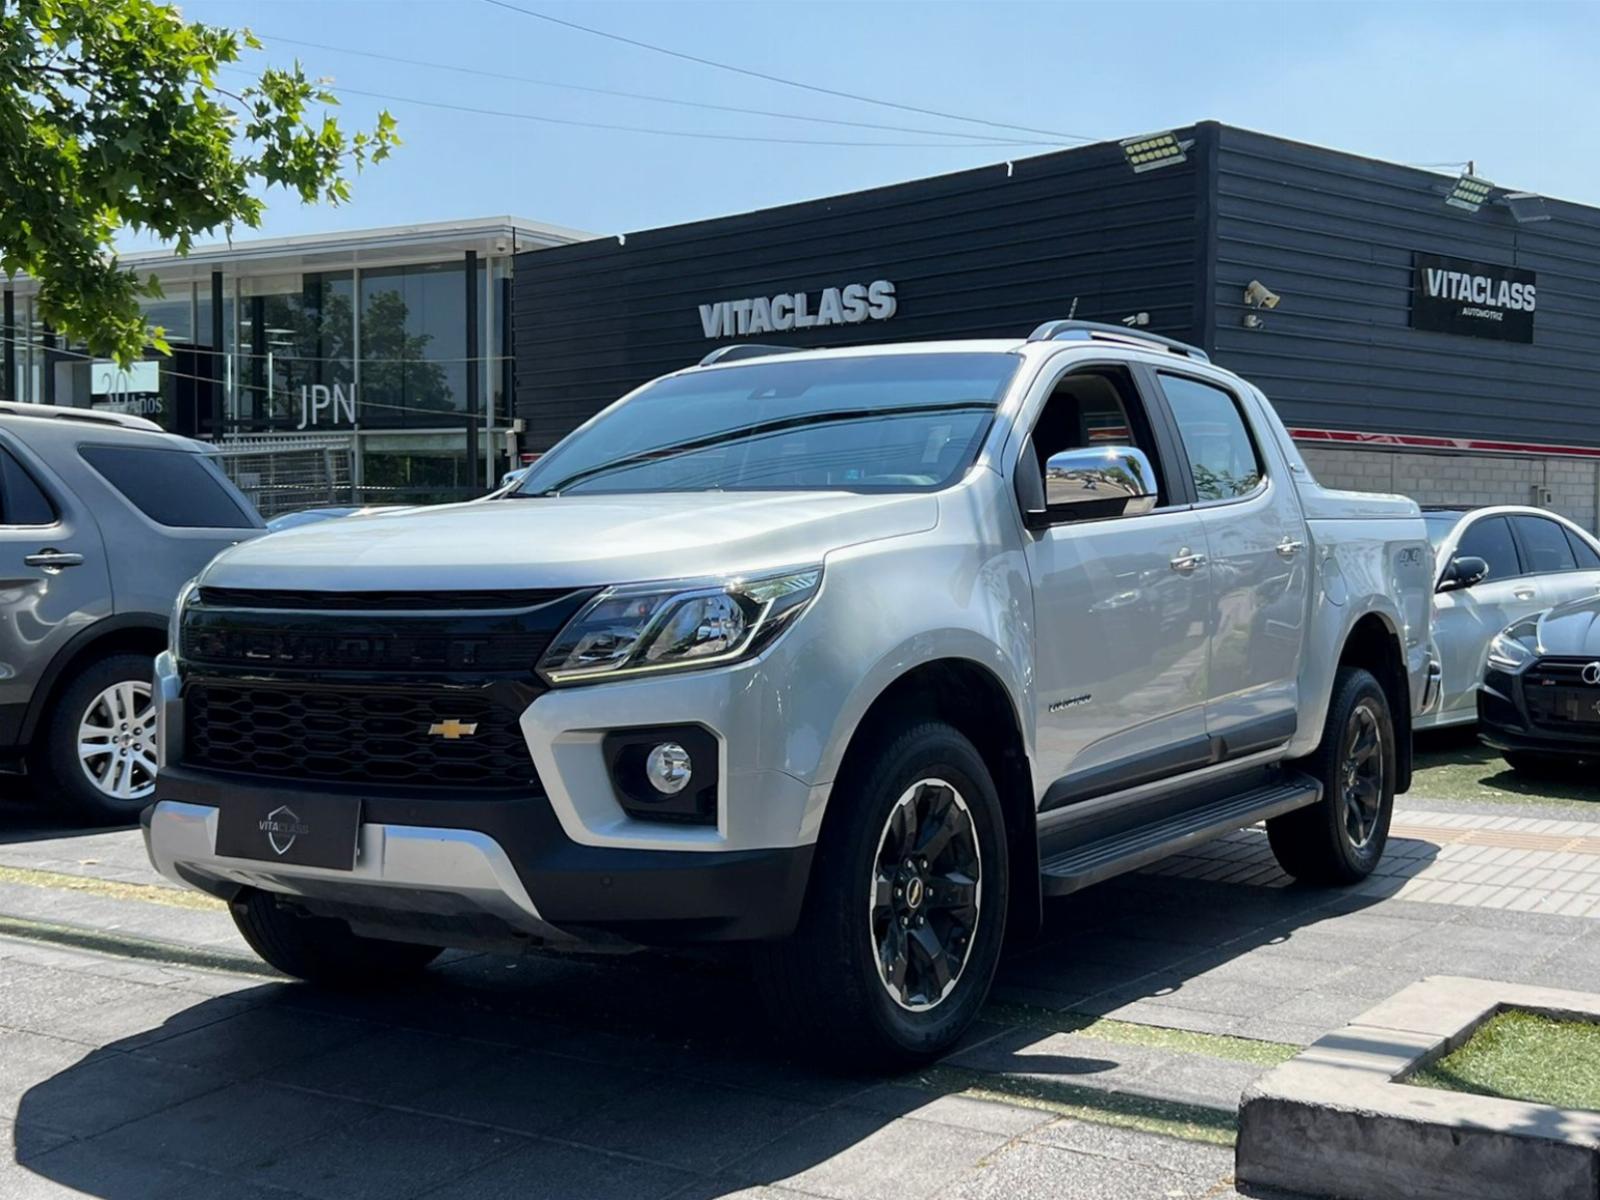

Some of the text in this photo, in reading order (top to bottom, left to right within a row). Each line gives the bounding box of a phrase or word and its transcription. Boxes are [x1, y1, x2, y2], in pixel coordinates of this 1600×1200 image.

[698, 279, 897, 339] VITACLASS
[1427, 267, 1537, 312] VITACLASS
[297, 383, 356, 430] JPN
